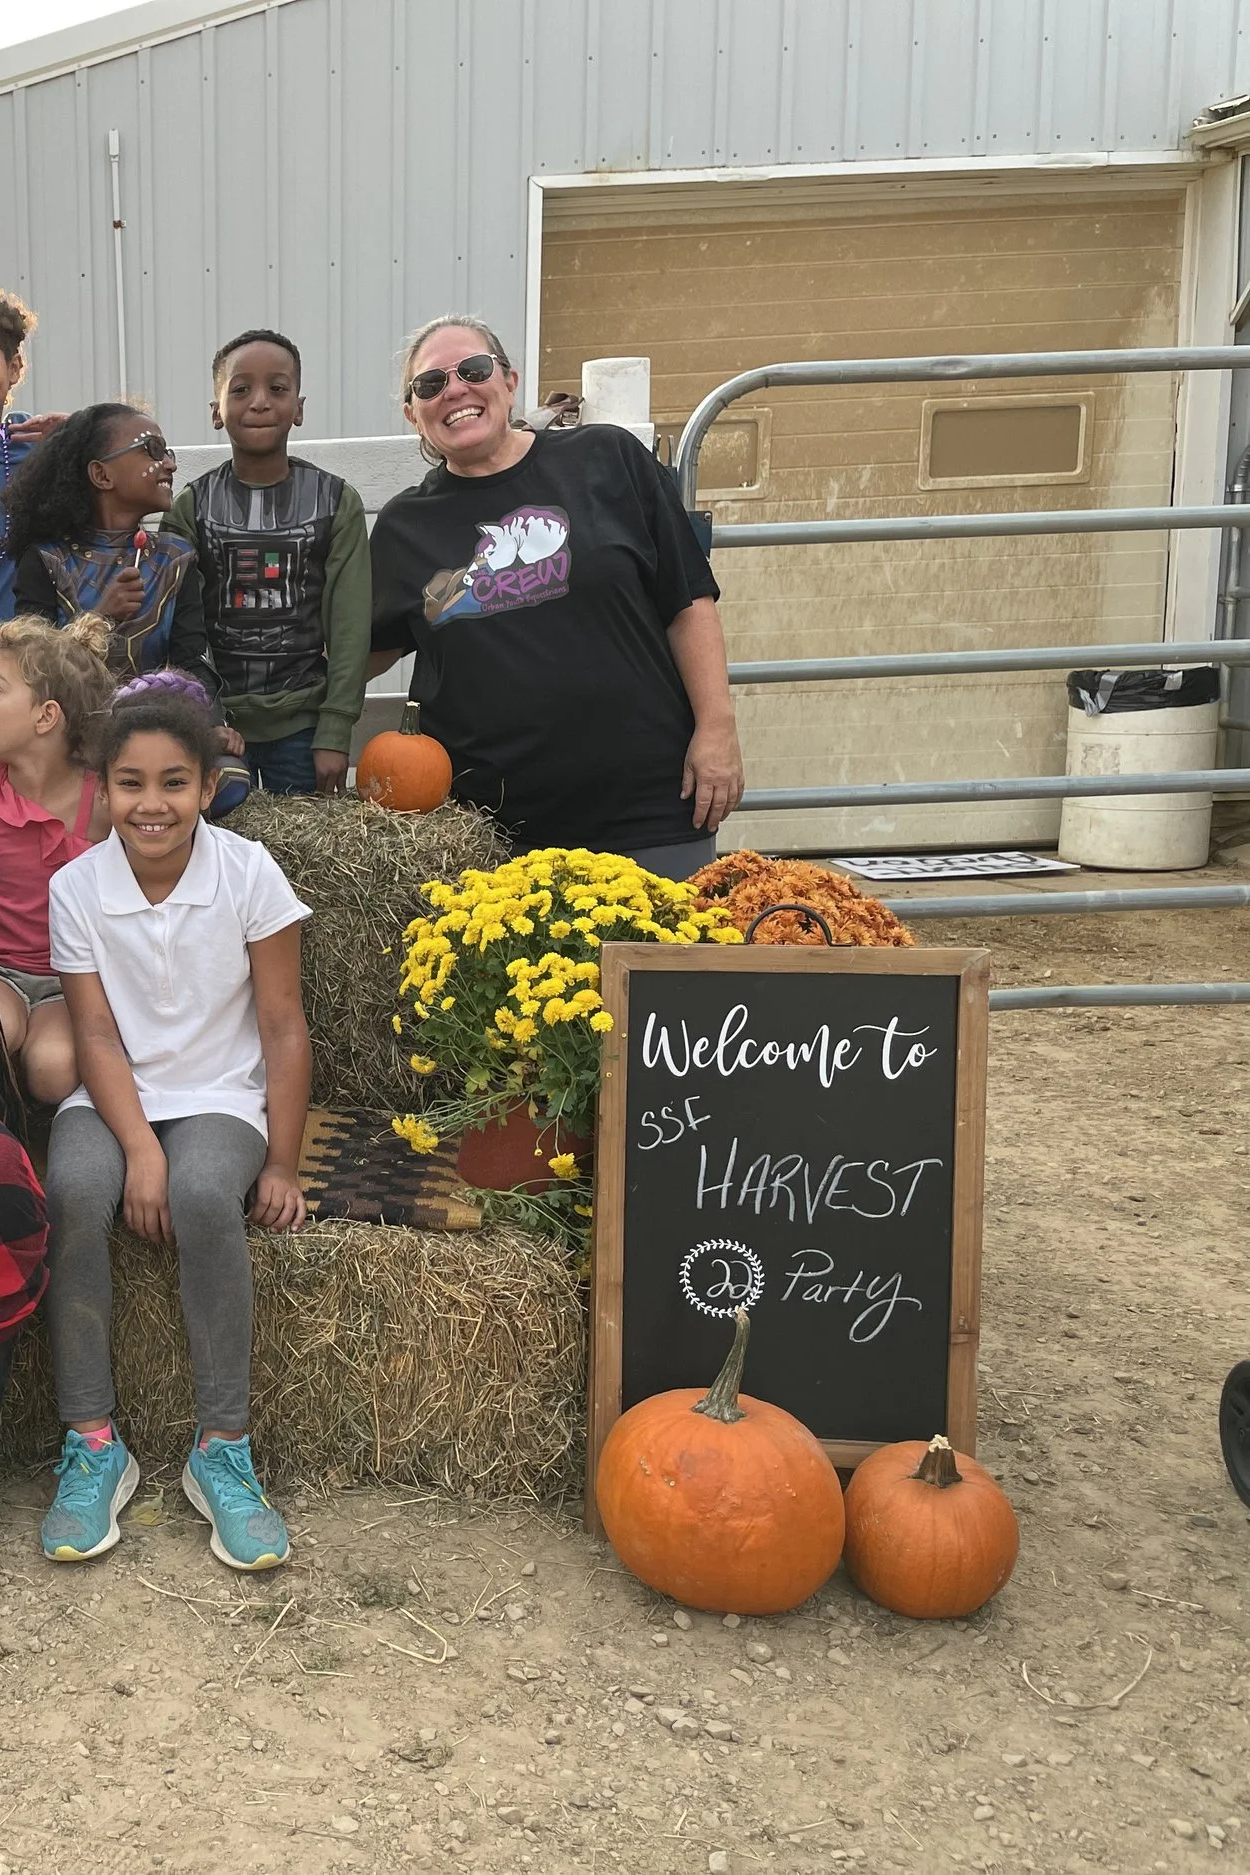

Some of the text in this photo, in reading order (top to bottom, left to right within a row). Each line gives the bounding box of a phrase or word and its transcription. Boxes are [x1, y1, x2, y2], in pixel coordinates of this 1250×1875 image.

[472, 551, 568, 603] CREW
[482, 602, 504, 612] Urban
[505, 597, 525, 608] Youth
[641, 1004, 938, 1088] Welcome to
[637, 1095, 711, 1150] SSF
[695, 1137, 944, 1225] HARVEST
[780, 1249, 923, 1344] Party
